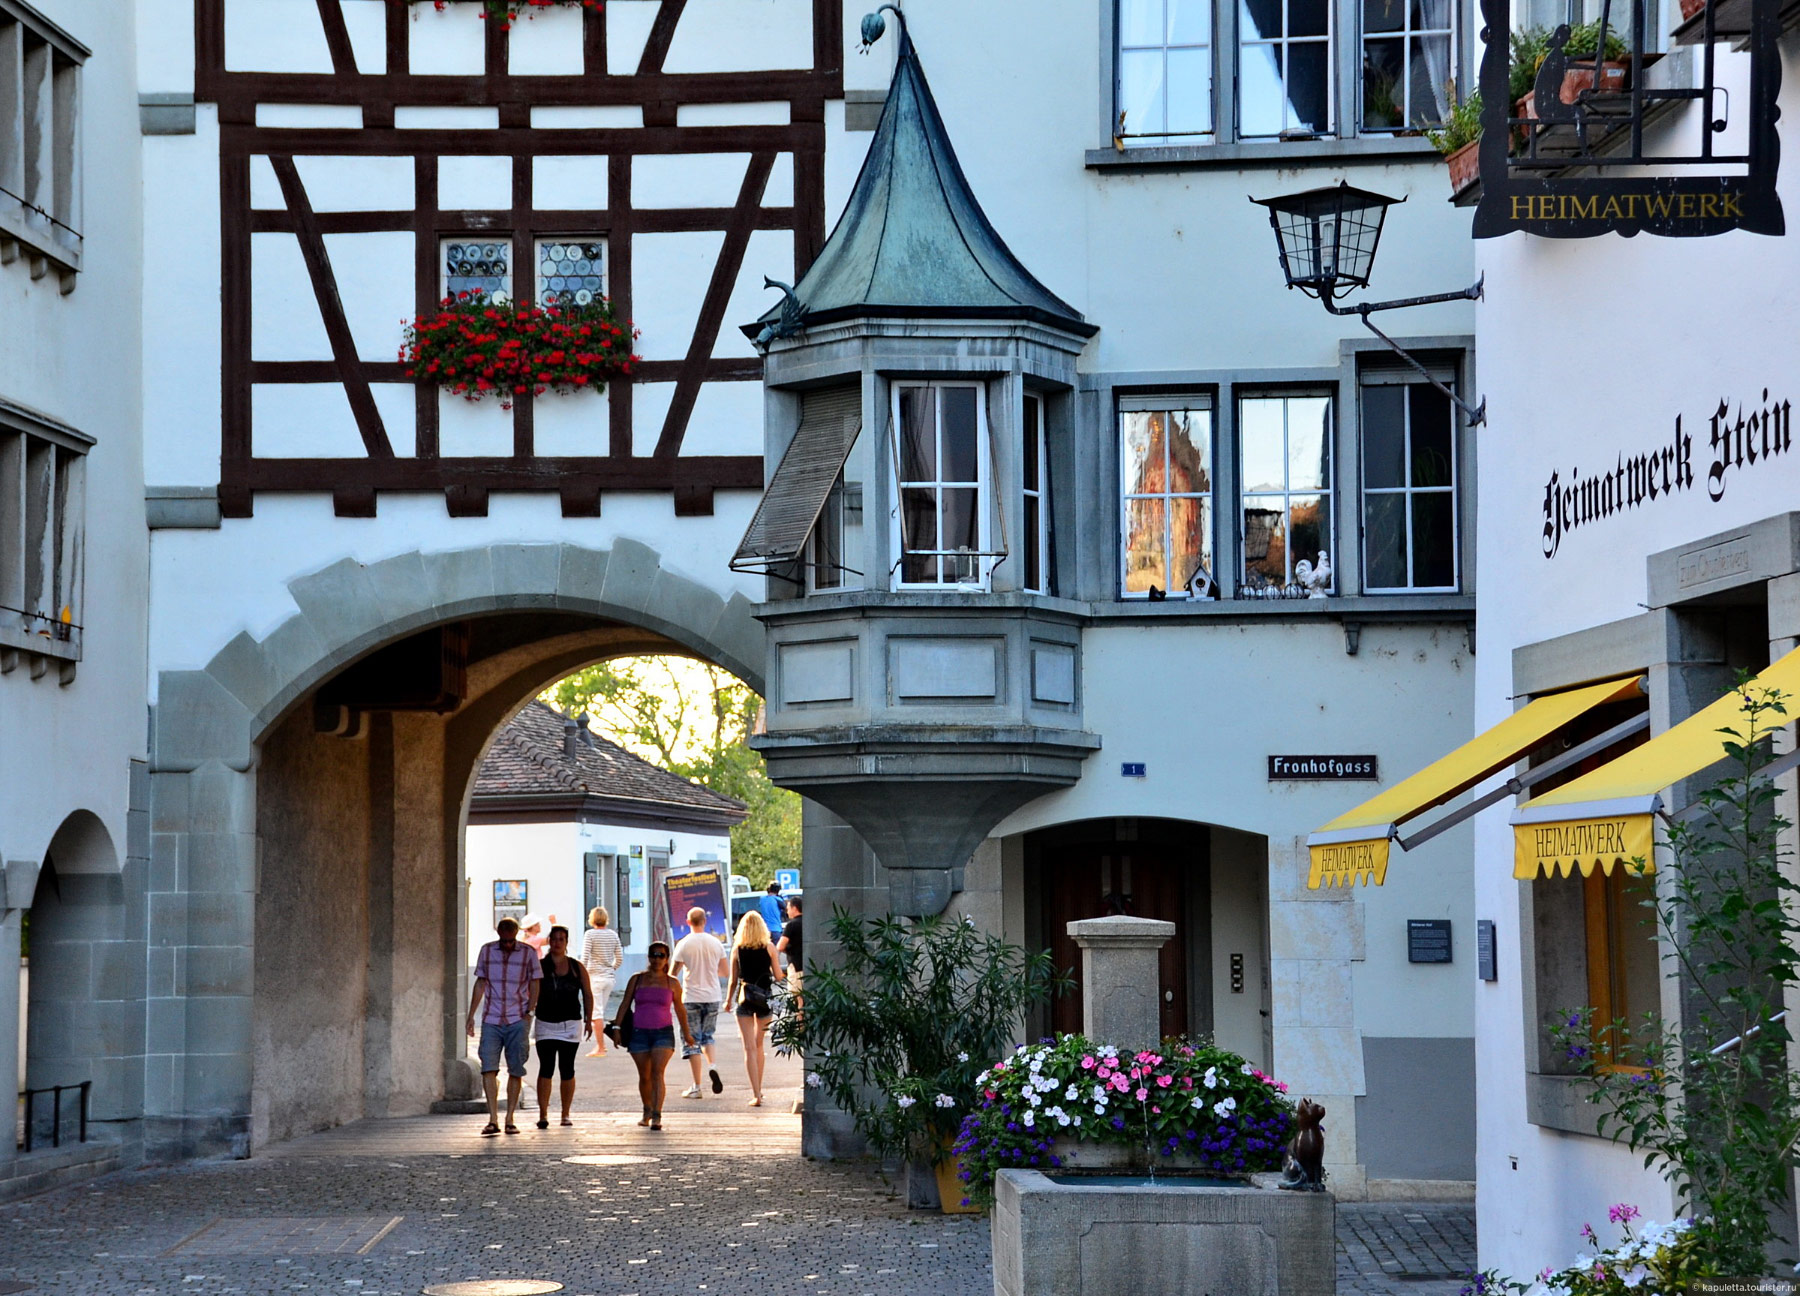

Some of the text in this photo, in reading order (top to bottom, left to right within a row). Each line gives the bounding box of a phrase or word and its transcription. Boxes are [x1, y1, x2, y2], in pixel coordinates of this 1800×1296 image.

[1509, 193, 1744, 219] HEIMATWERK
[1542, 387, 1792, 560] Heimatwerk Stein
[1273, 757, 1371, 777] Fronhofgass
[1535, 822, 1627, 858] HEIMATWERK
[1321, 844, 1375, 872] HEIMATWERK
